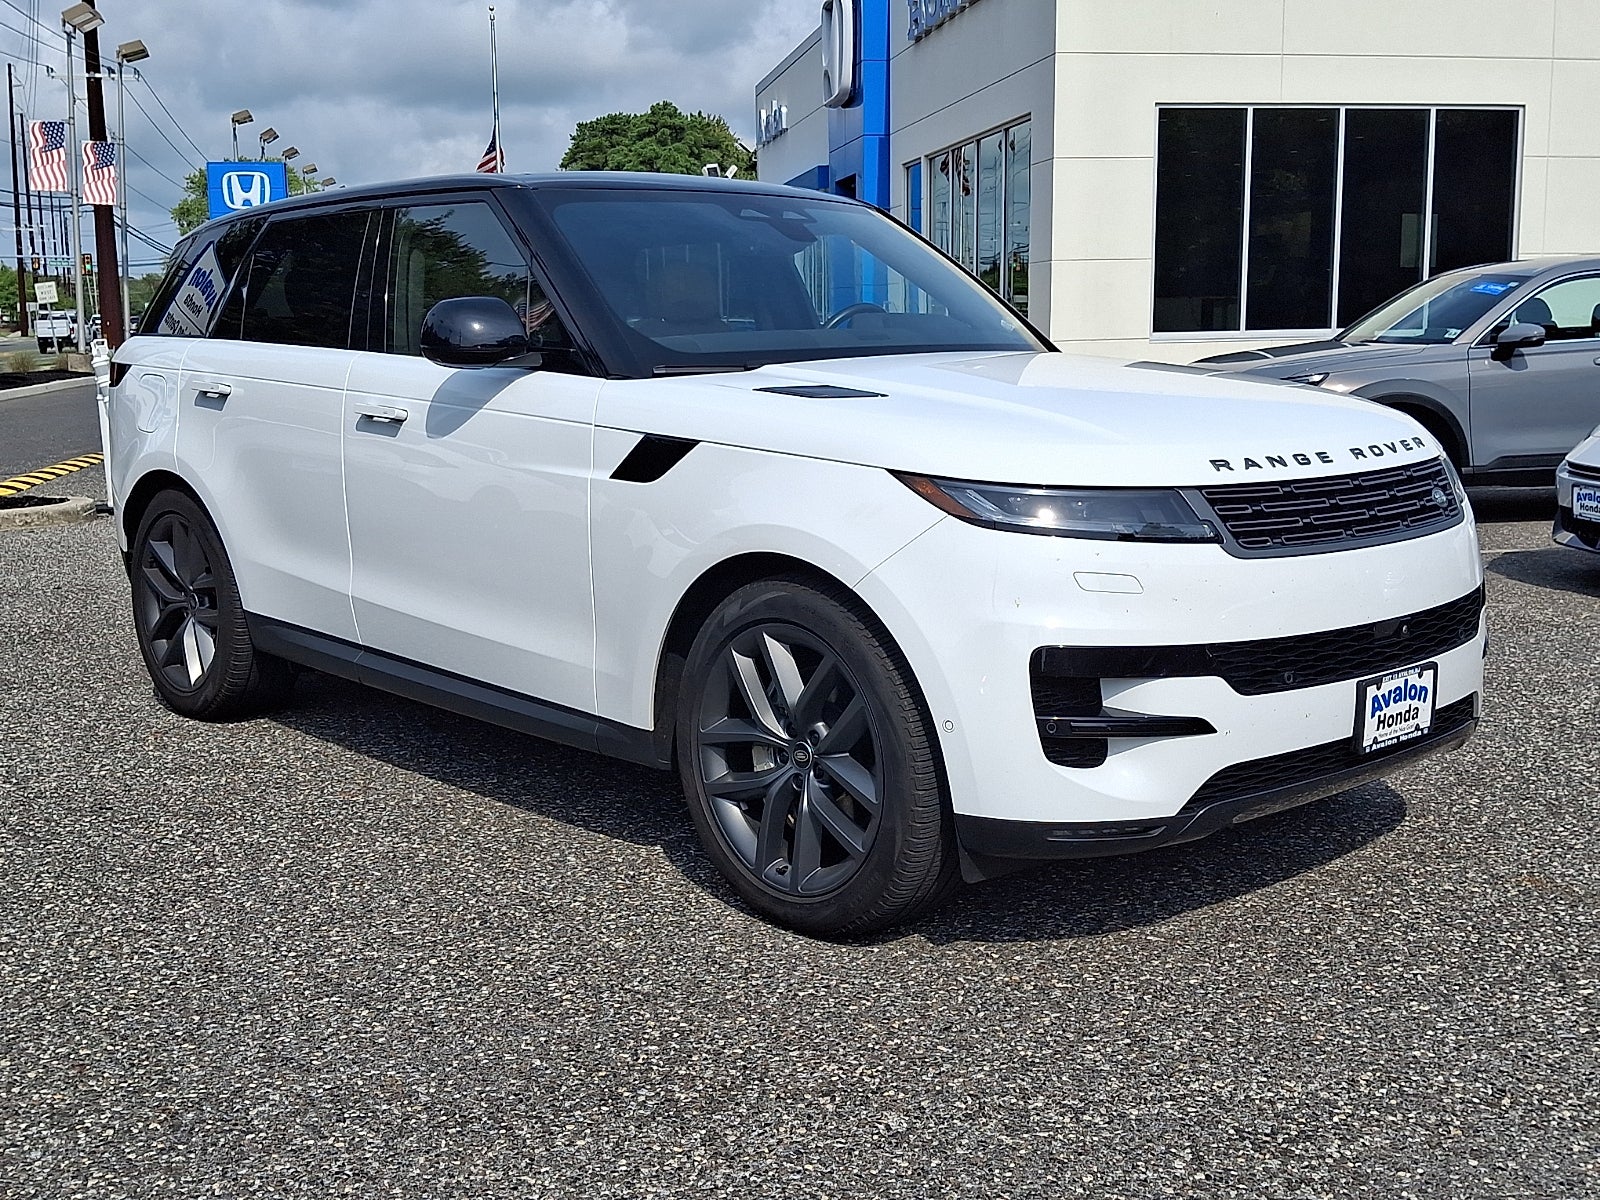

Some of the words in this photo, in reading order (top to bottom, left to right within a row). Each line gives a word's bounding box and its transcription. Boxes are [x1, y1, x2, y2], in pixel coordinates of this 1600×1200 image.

[1209, 452, 1333, 472] RANGE
[1349, 436, 1426, 460] ROVER
[1580, 502, 1600, 513] Hond
[1371, 678, 1429, 719] Avalon
[1376, 704, 1420, 731] Honda
[1371, 738, 1398, 751] Avalon
[1399, 730, 1422, 742] Honda
